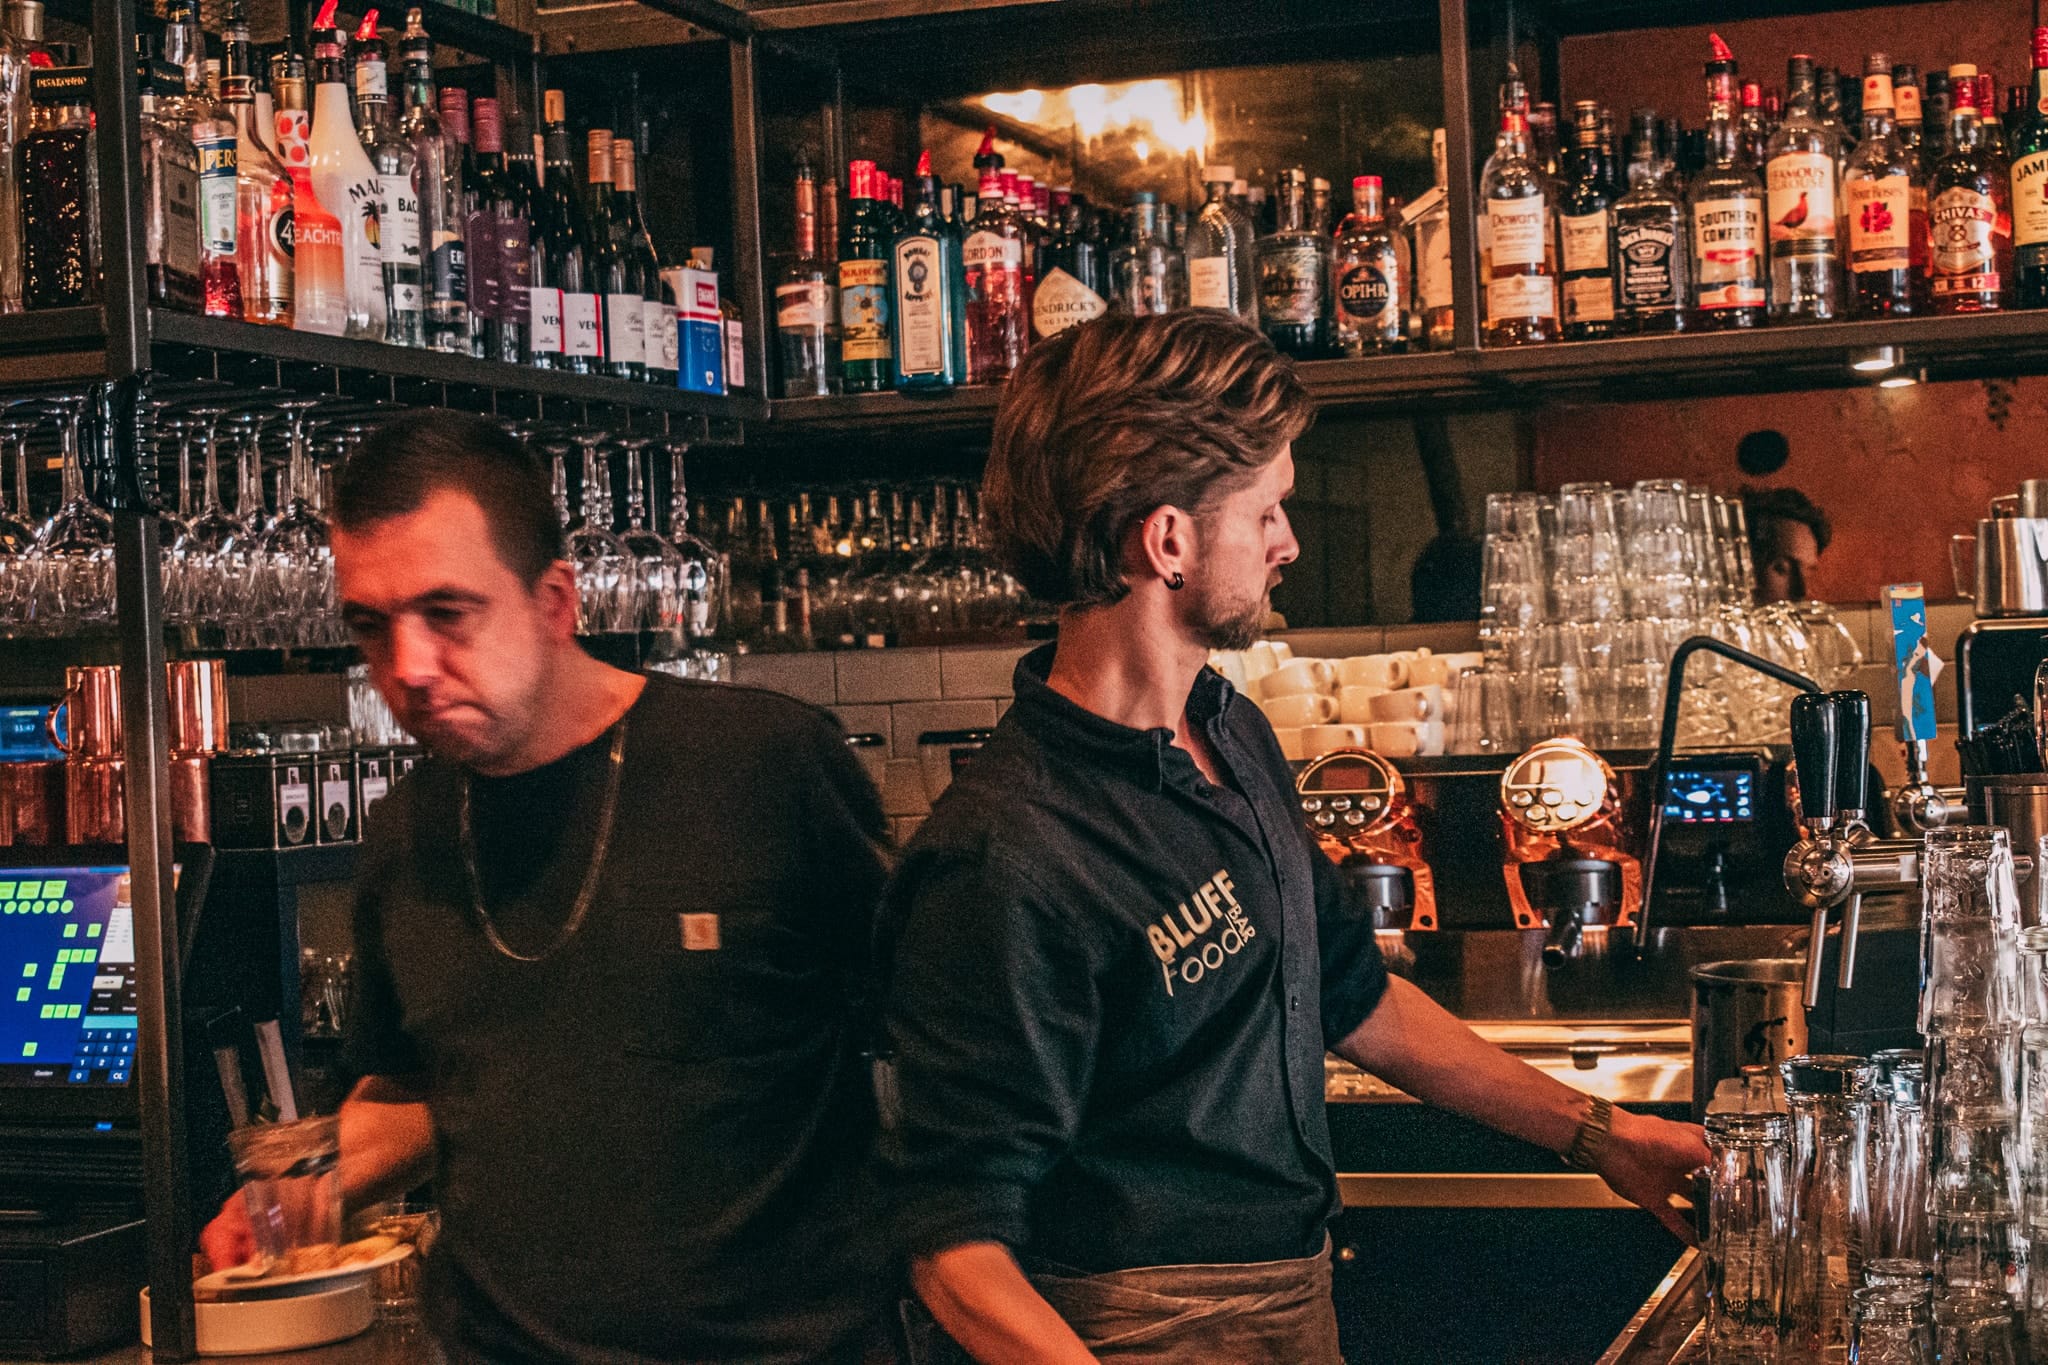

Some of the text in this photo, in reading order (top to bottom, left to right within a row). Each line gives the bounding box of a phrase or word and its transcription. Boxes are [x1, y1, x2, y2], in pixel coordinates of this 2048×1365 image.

[2016, 158, 2048, 182] JAM
[349, 178, 380, 203] MAL
[398, 197, 417, 213] BAC
[1934, 206, 1985, 223] CHIVAS
[1703, 227, 1756, 244] COMFORT
[1342, 283, 1389, 299] OPIHR
[1972, 277, 1986, 289] 12
[1146, 868, 1238, 963] BLUFF
[1227, 903, 1256, 944] BAR
